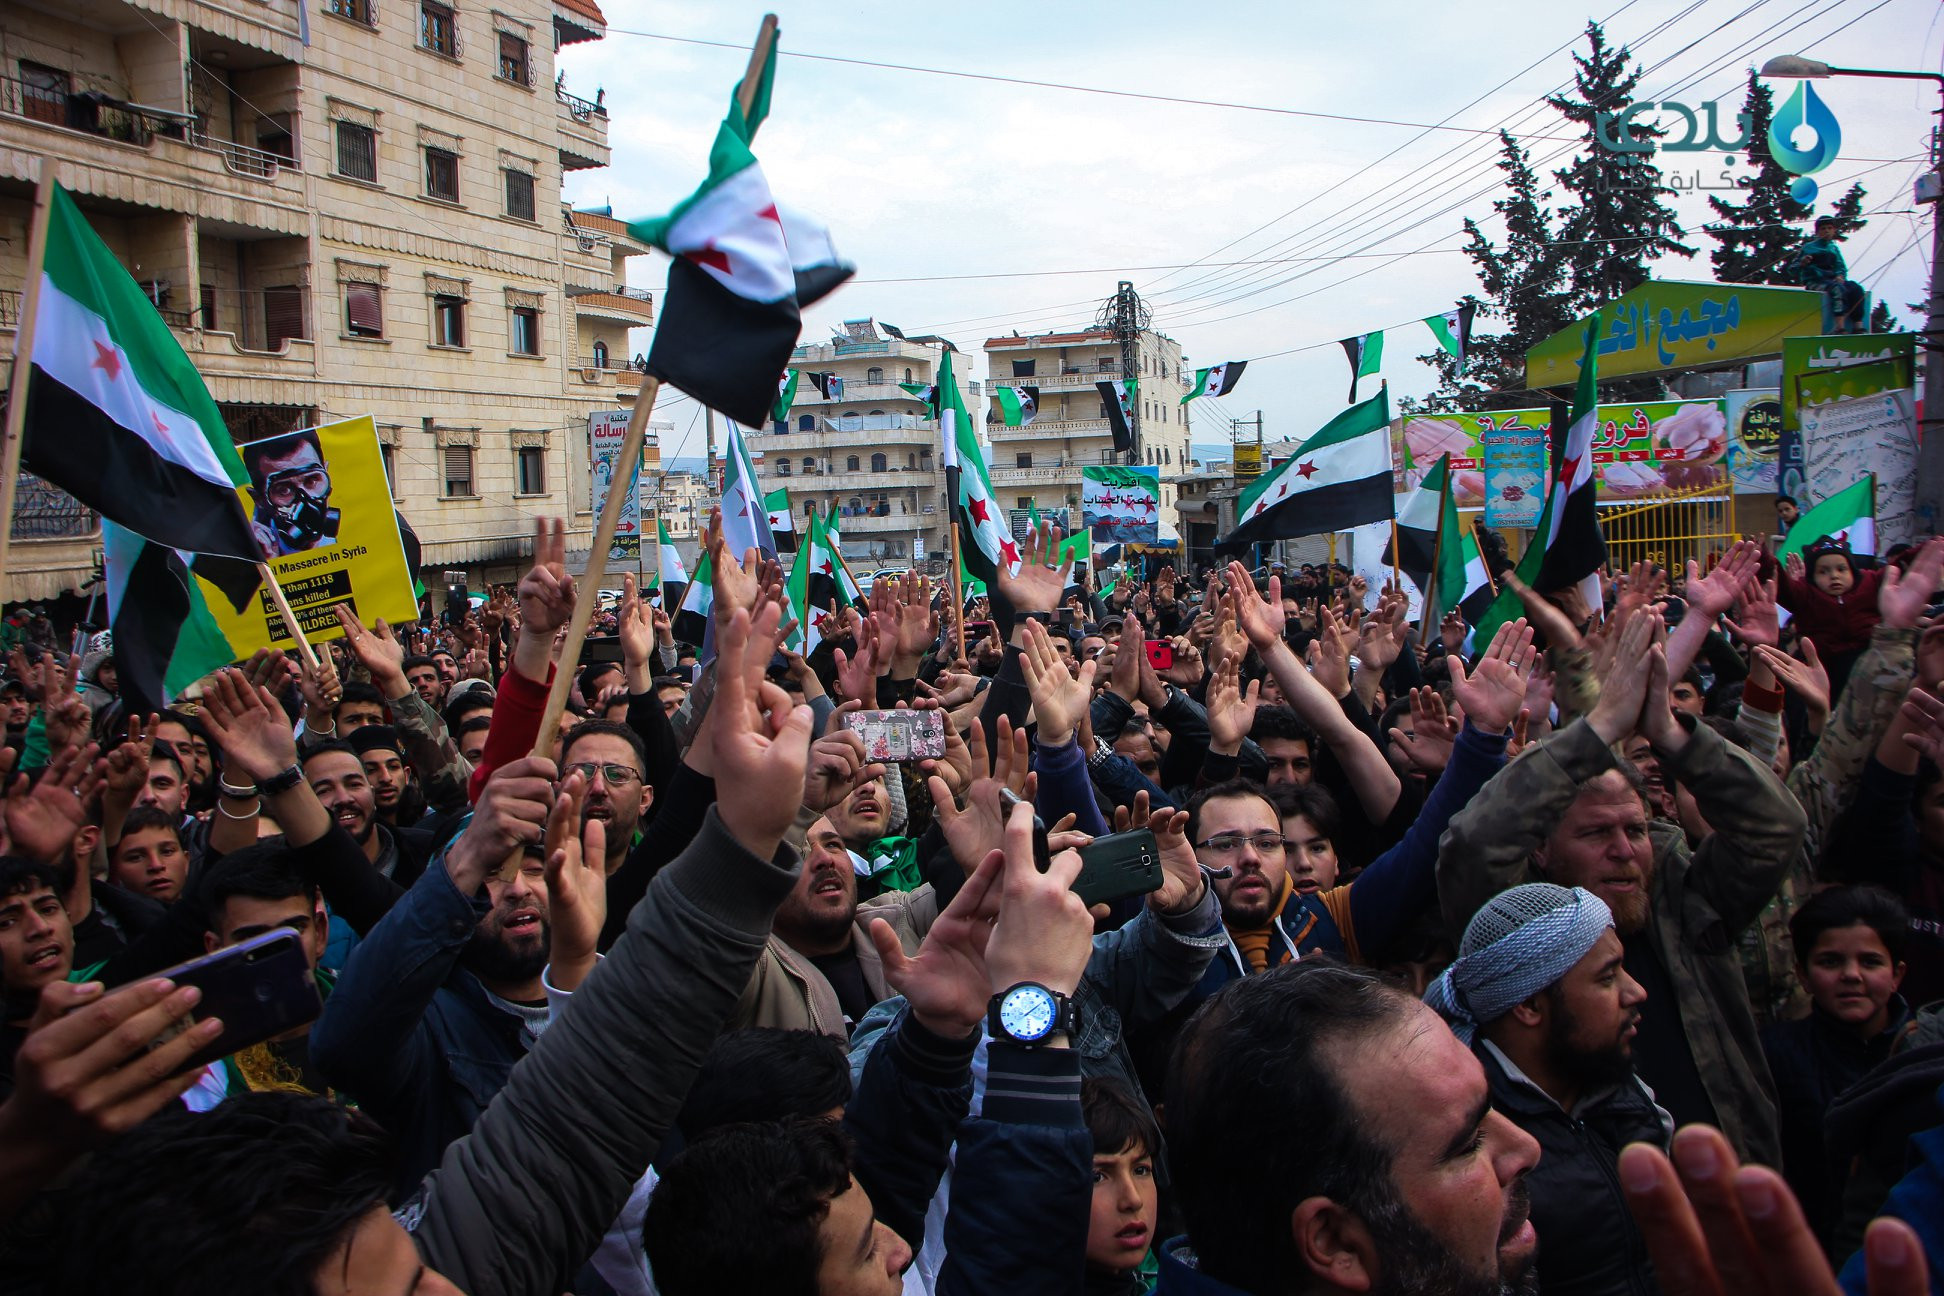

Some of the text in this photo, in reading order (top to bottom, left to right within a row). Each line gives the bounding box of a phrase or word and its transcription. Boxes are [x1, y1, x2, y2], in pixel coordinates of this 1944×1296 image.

[1575, 294, 1741, 369] مجمع الخر
[1808, 345, 1892, 374] مسجد
[610, 414, 628, 423] مكتبة
[594, 422, 631, 441] رسالة
[1744, 426, 1781, 444] والات
[1122, 516, 1147, 528] قانون
[279, 556, 329, 575] Massacre
[329, 552, 341, 562] in
[341, 545, 368, 560] Syria
[262, 574, 334, 599] Me than 1118
[304, 589, 331, 603] killed
[308, 607, 317, 617] of
[271, 612, 341, 640] just ILDREN
